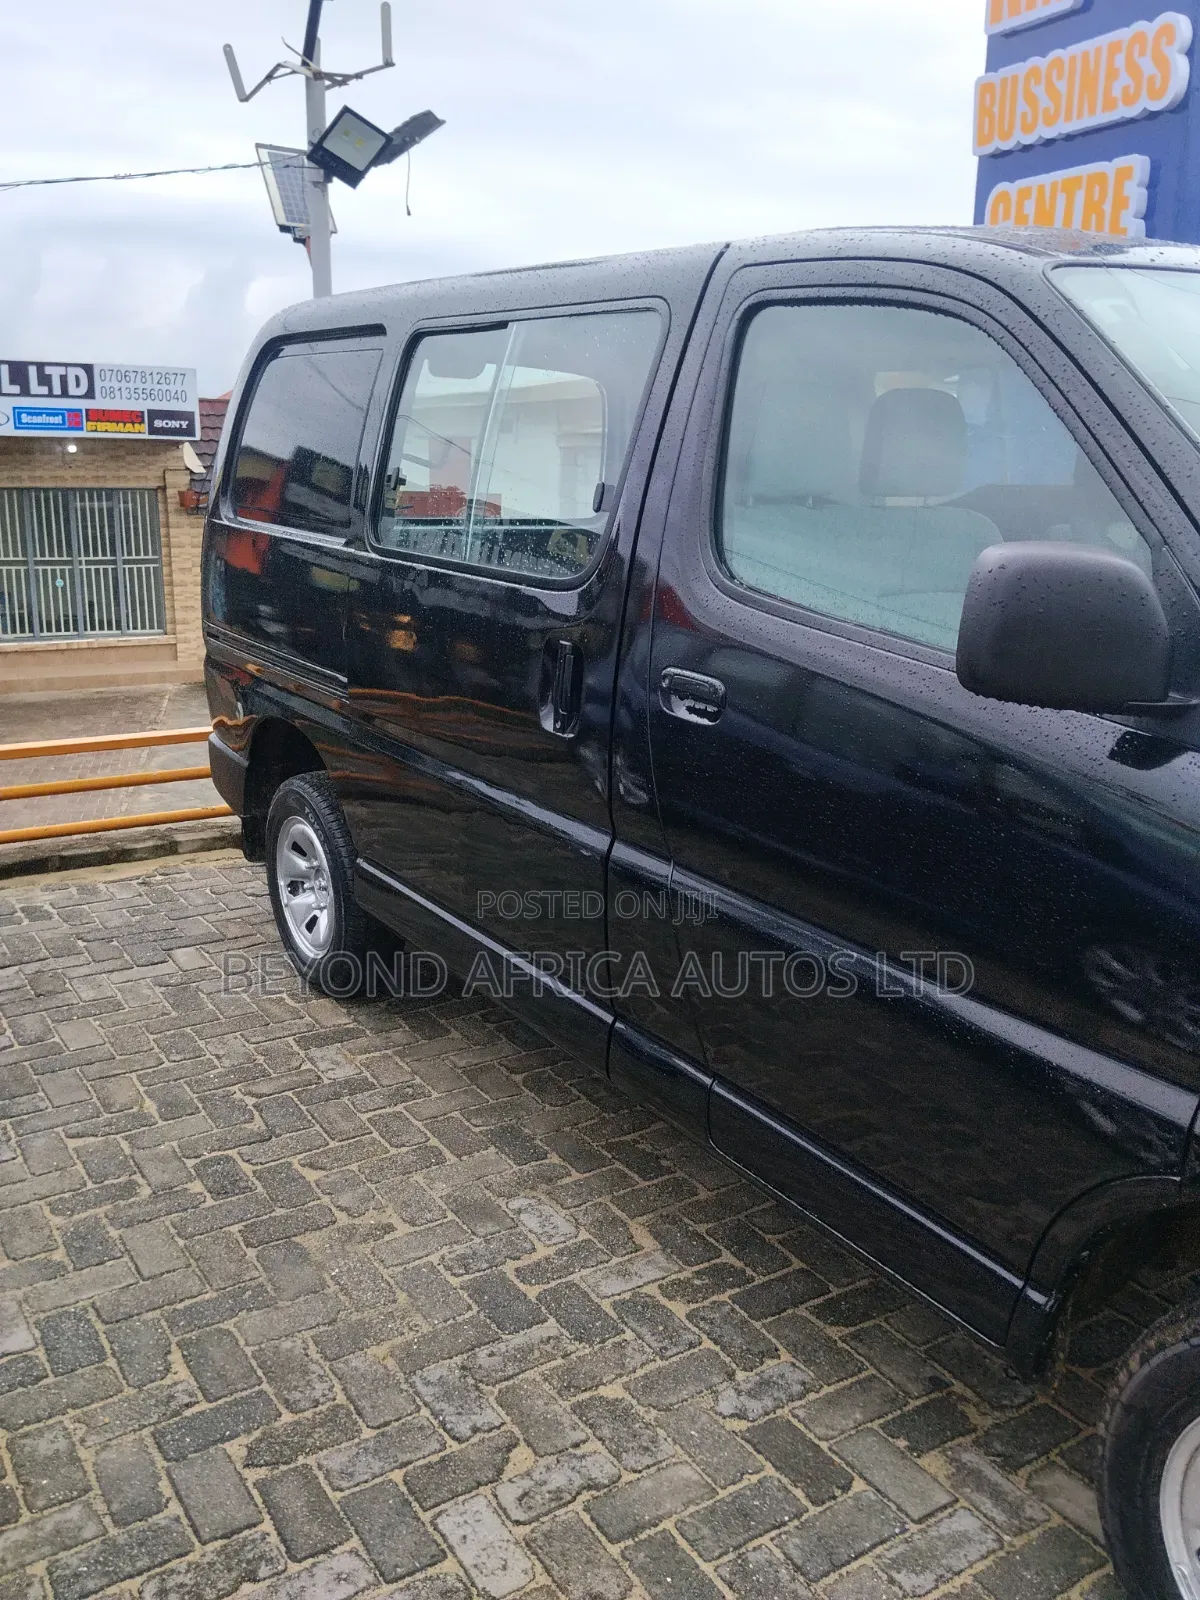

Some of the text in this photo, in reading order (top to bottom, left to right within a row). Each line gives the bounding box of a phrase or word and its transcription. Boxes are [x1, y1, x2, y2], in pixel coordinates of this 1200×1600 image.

[976, 23, 1177, 148] BUSSINESS
[989, 165, 1134, 236] CENTRE
[28, 365, 89, 396] LTD
[99, 368, 187, 387] 07067812677
[100, 385, 188, 403] 08135560040
[88, 408, 143, 422] SUMEC
[153, 419, 189, 429] SONY
